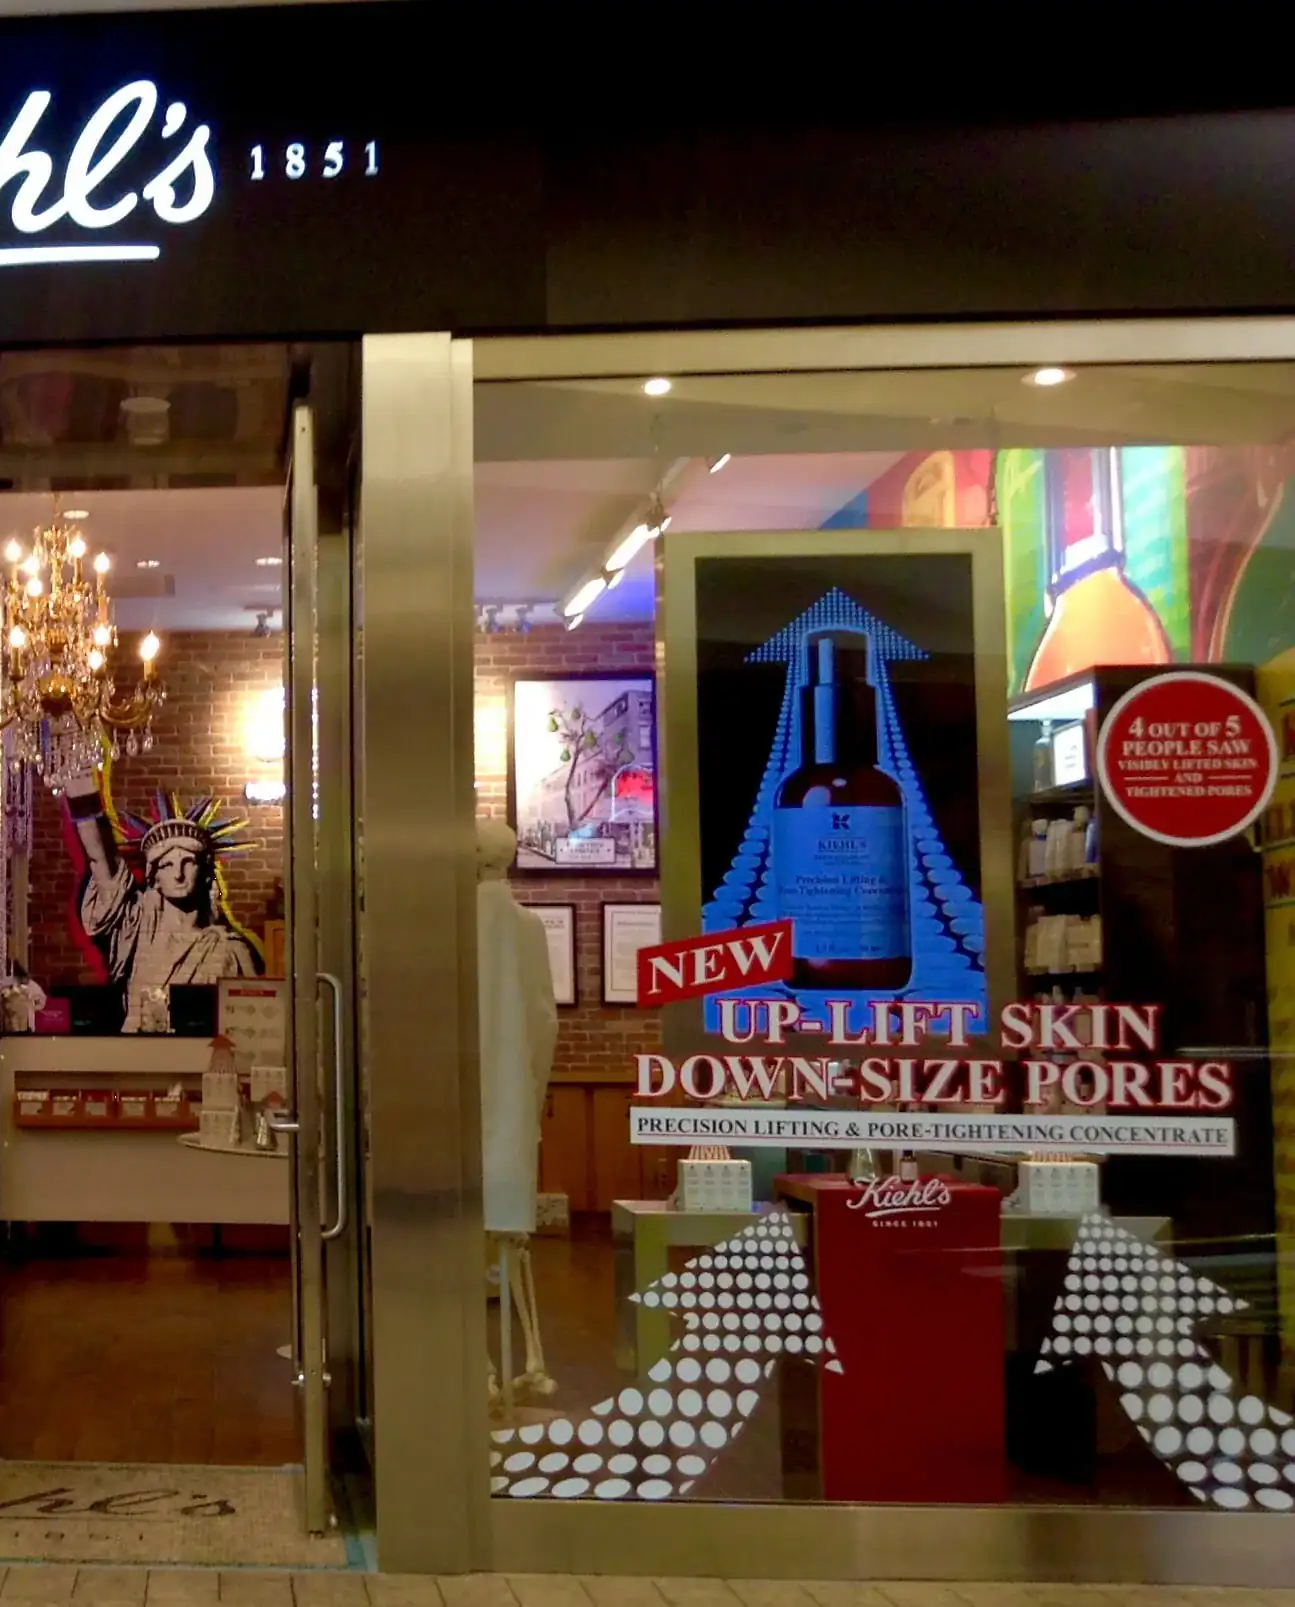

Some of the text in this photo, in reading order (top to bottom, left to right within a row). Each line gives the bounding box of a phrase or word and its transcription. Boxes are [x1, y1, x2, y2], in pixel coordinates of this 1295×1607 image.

[250, 139, 380, 181] 1851
[1128, 715, 1242, 738] 4 OUT OF 5
[1122, 738, 1252, 756] PEOPLE SAW
[1117, 757, 1259, 771] VISIBLY LIFTED SKIN
[1174, 772, 1203, 784] AND
[1125, 784, 1253, 798] TIGHTENED PORES
[646, 931, 785, 994] NEW
[716, 999, 1159, 1051] UP-LIFT SKIN
[633, 1054, 1232, 1108] DOWN-SIZE PORES
[637, 1116, 1229, 1145] PRECISION LIFTING & PORE-TIGHTENING CONCENTRATE
[846, 1175, 951, 1209] Kiehl's
